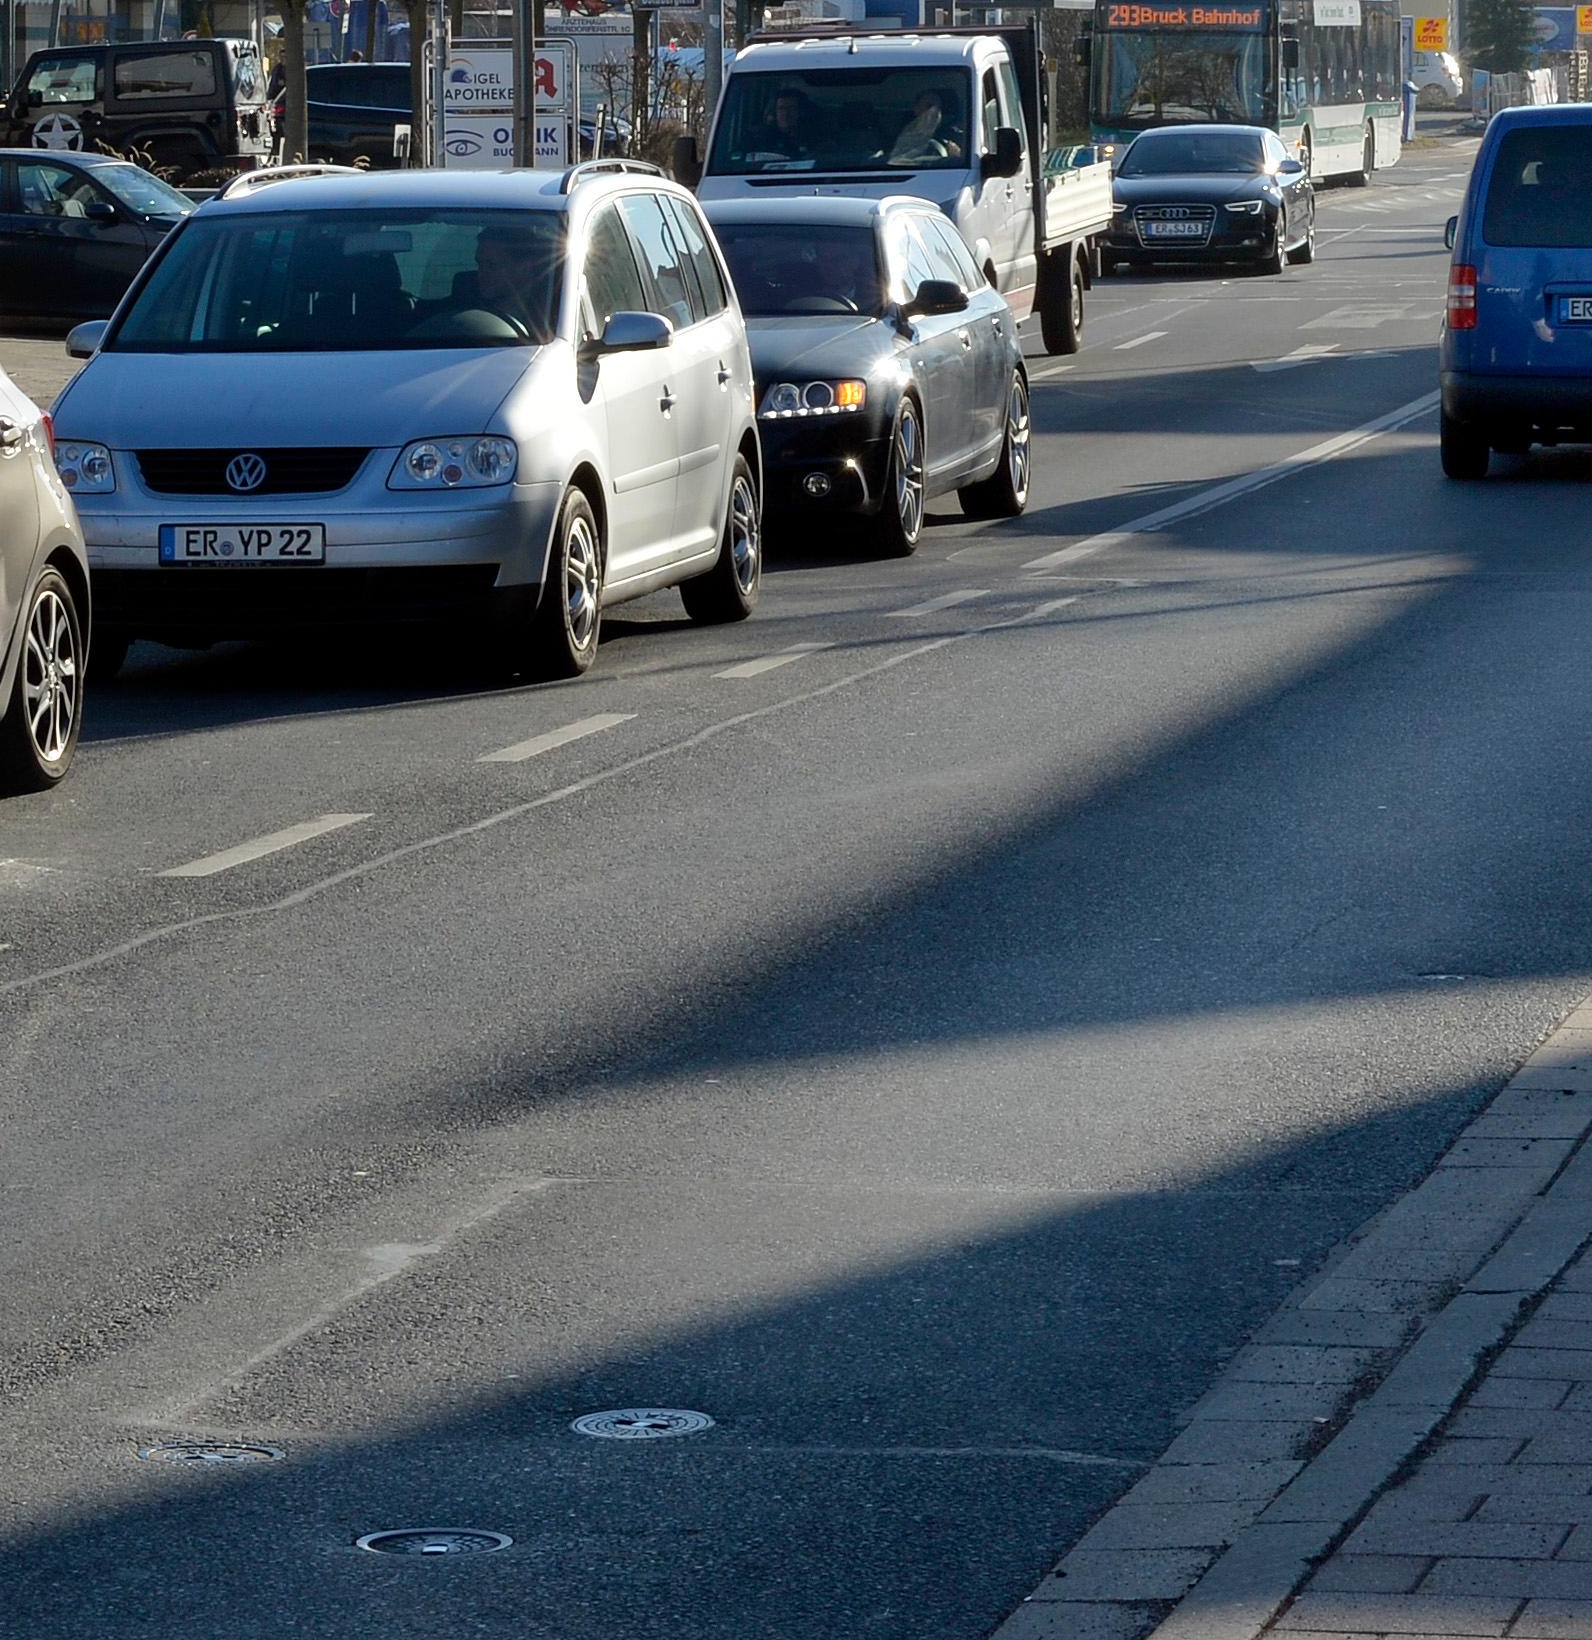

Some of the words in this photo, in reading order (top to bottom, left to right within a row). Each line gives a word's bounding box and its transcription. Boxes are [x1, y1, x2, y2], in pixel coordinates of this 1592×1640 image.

[1108, 5, 1140, 26] 293
[1140, 7, 1186, 24] Bruck
[1192, 7, 1261, 25] Bahnhof
[1417, 35, 1443, 44] LOTTO
[474, 73, 501, 85] IGEL
[444, 88, 514, 101] APOTHEKE
[493, 127, 558, 144] OIK
[493, 147, 559, 157] BUCANN
[1571, 300, 1592, 317] ER
[186, 530, 219, 556] ER
[239, 530, 272, 556] YP
[279, 529, 312, 556] 22
